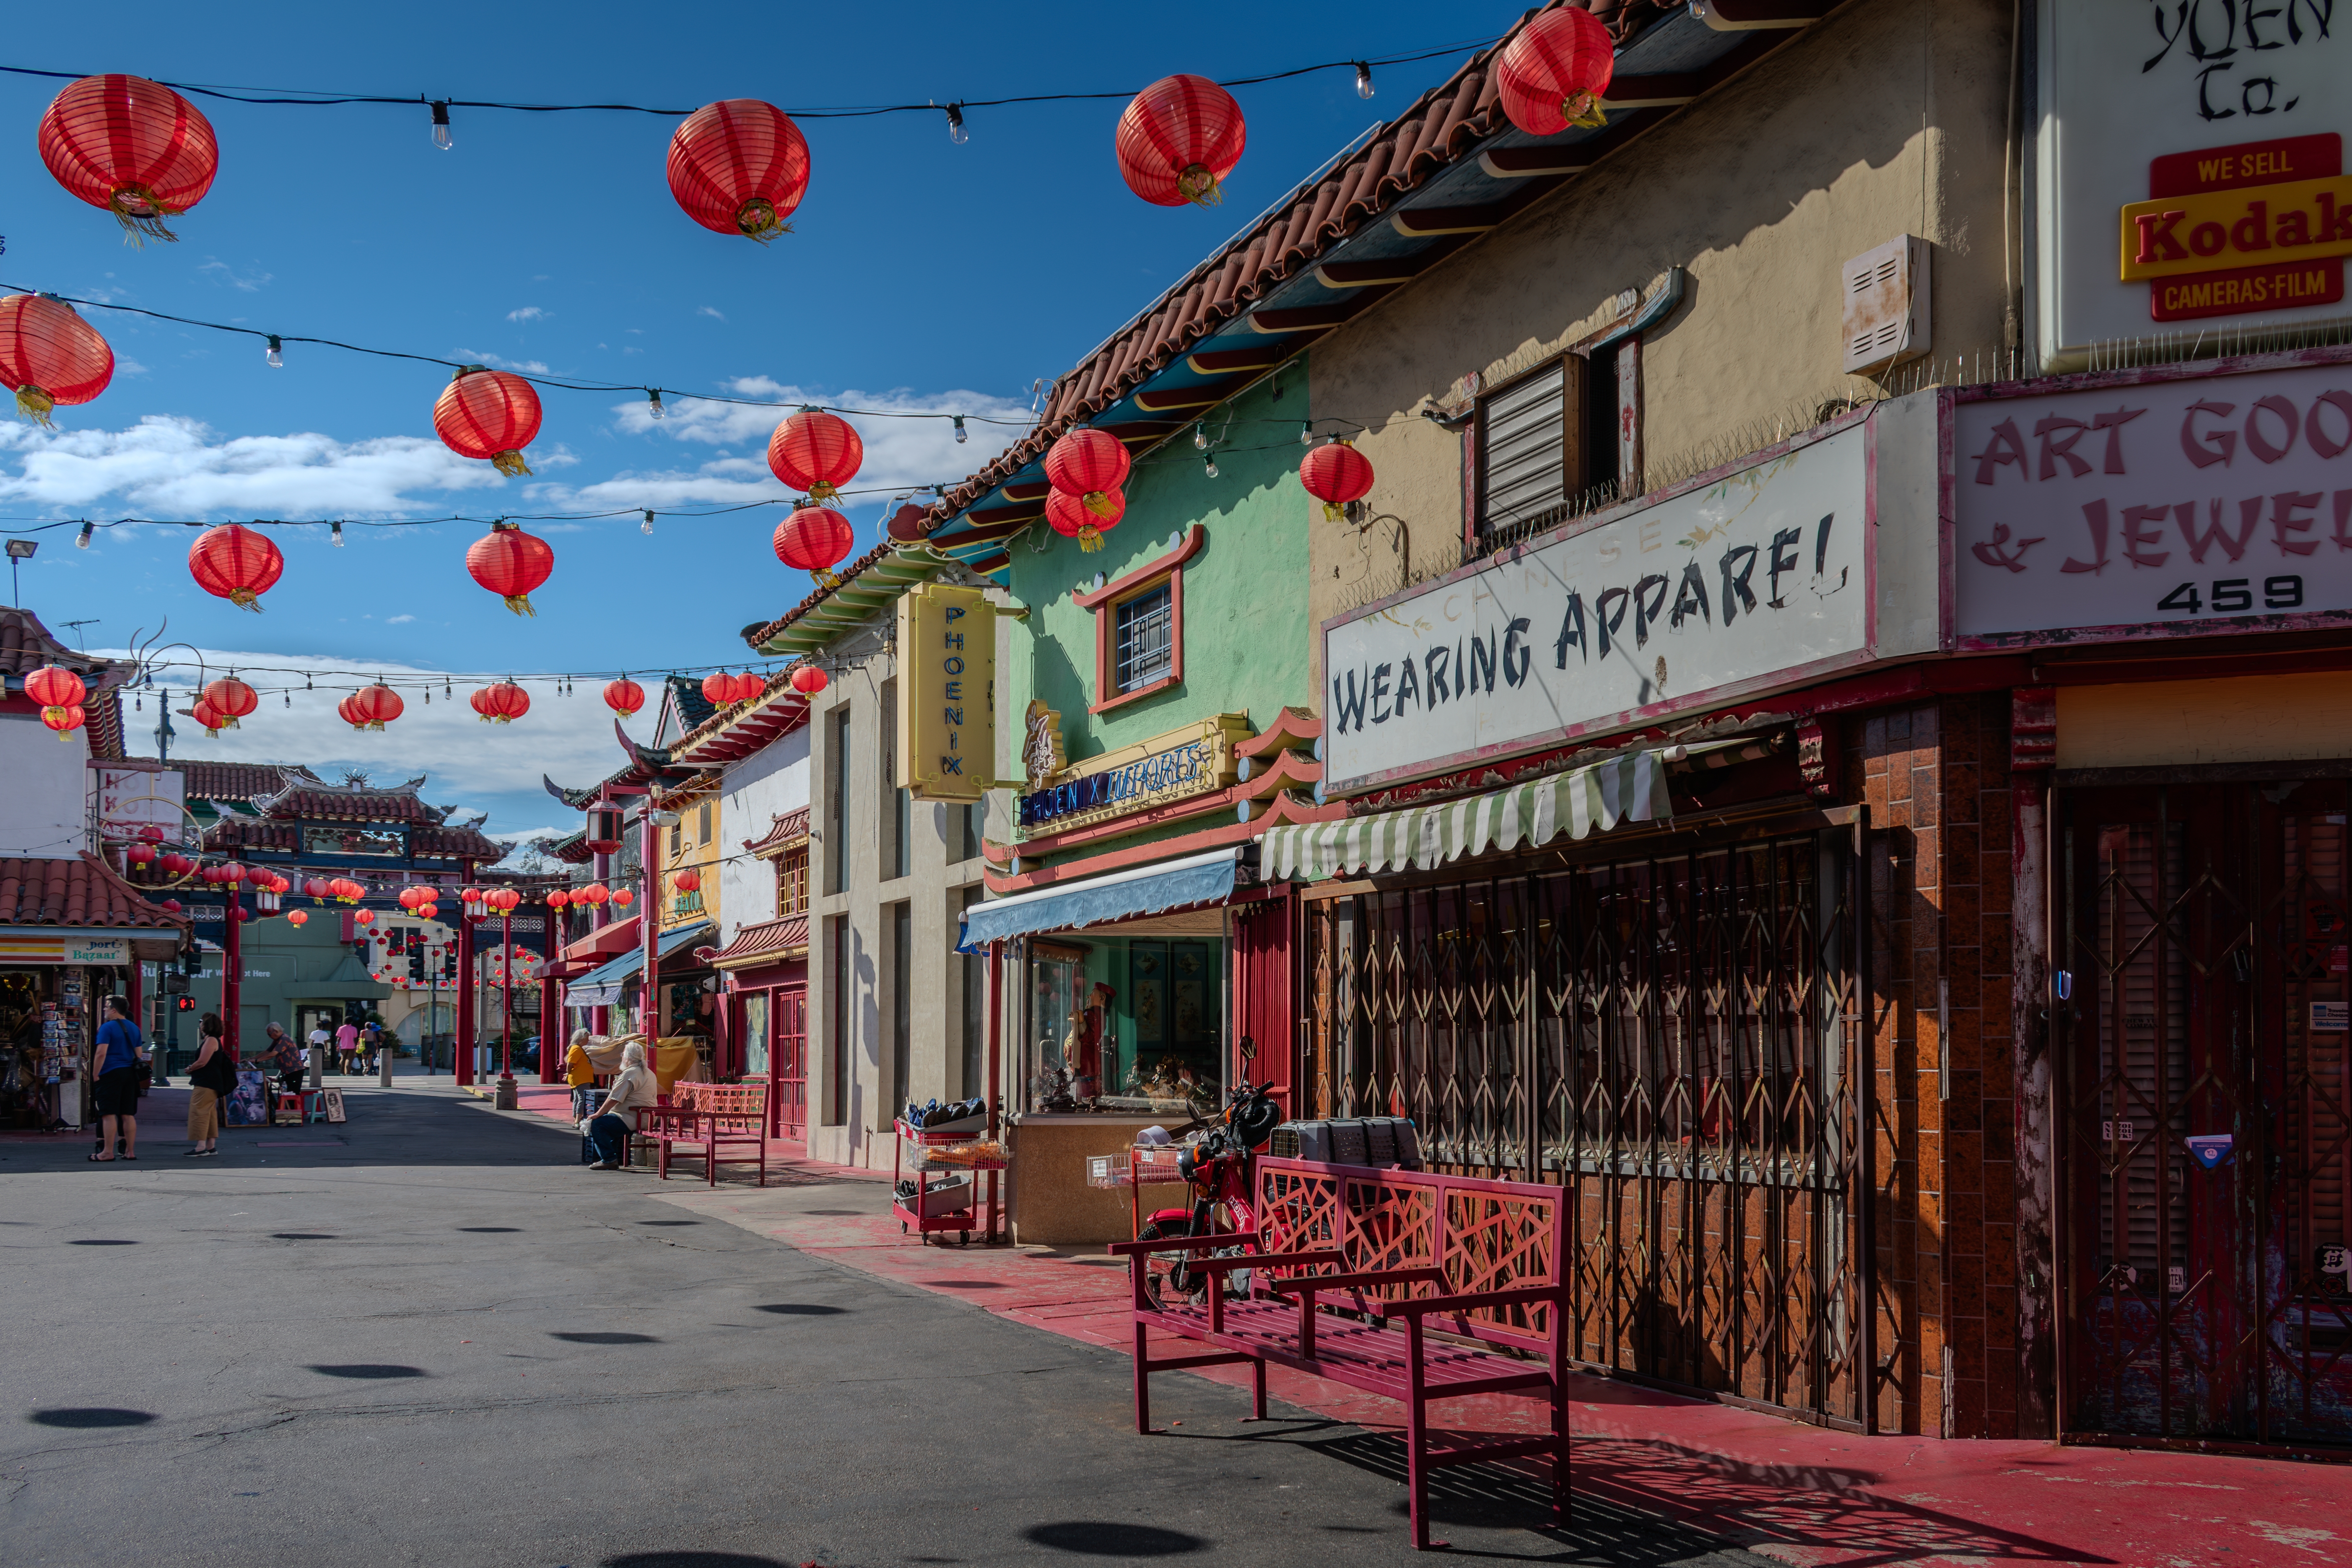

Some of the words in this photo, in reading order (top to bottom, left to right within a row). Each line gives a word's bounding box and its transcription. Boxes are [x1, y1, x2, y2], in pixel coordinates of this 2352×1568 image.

[2198, 158, 2233, 183] WE
[2241, 151, 2293, 177] SELL
[2135, 192, 2352, 265] Kodak
[2165, 270, 2326, 311] CAMERAS-FILM
[1971, 405, 2148, 485] ART
[1971, 522, 2046, 573] &
[2157, 575, 2303, 614] 459
[1333, 615, 1531, 737] WEARING
[1554, 511, 1848, 671] APPAREL
[943, 607, 966, 776] PHOENIX
[1020, 773, 1110, 826] PHOENIX
[1104, 742, 1202, 803] IMPORTS
[73, 950, 120, 962] Bazaar
[86, 940, 122, 950] port
